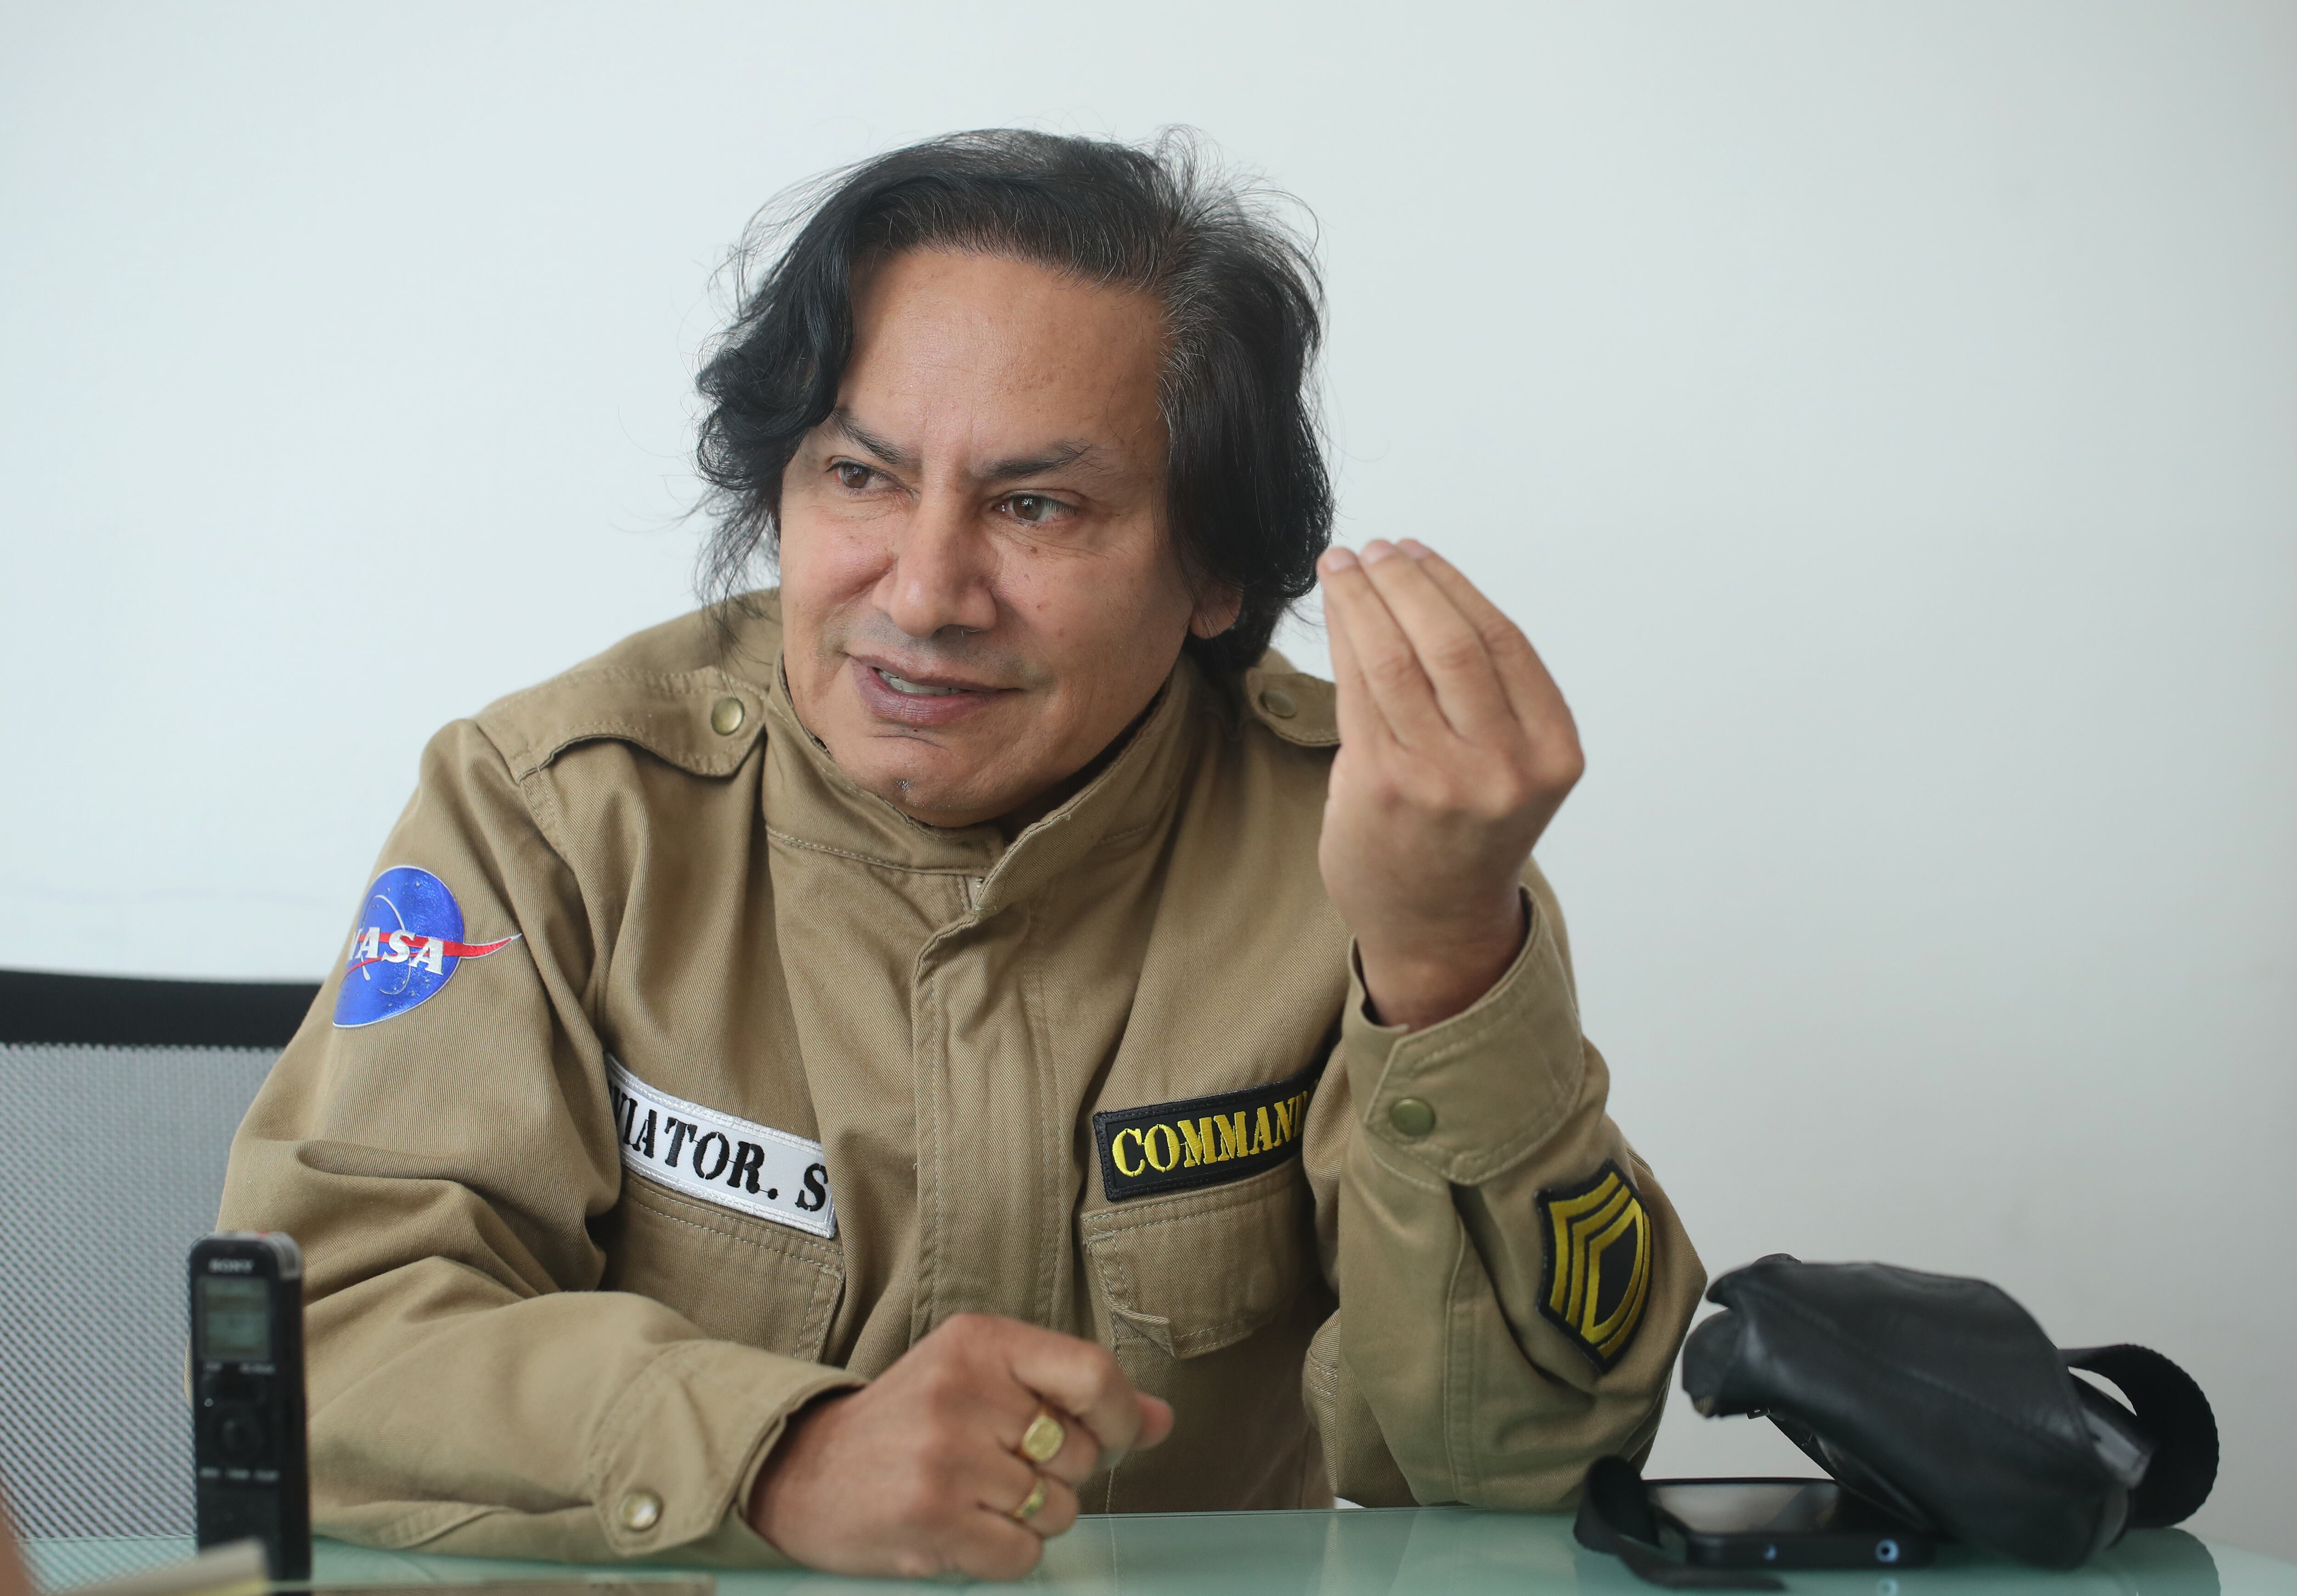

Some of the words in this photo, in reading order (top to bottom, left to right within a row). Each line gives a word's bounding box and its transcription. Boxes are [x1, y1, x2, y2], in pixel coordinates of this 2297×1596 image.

[609, 1079, 778, 1200] VIATOR.
[795, 1162, 828, 1212] S
[208, 1258, 254, 1274] SONY
